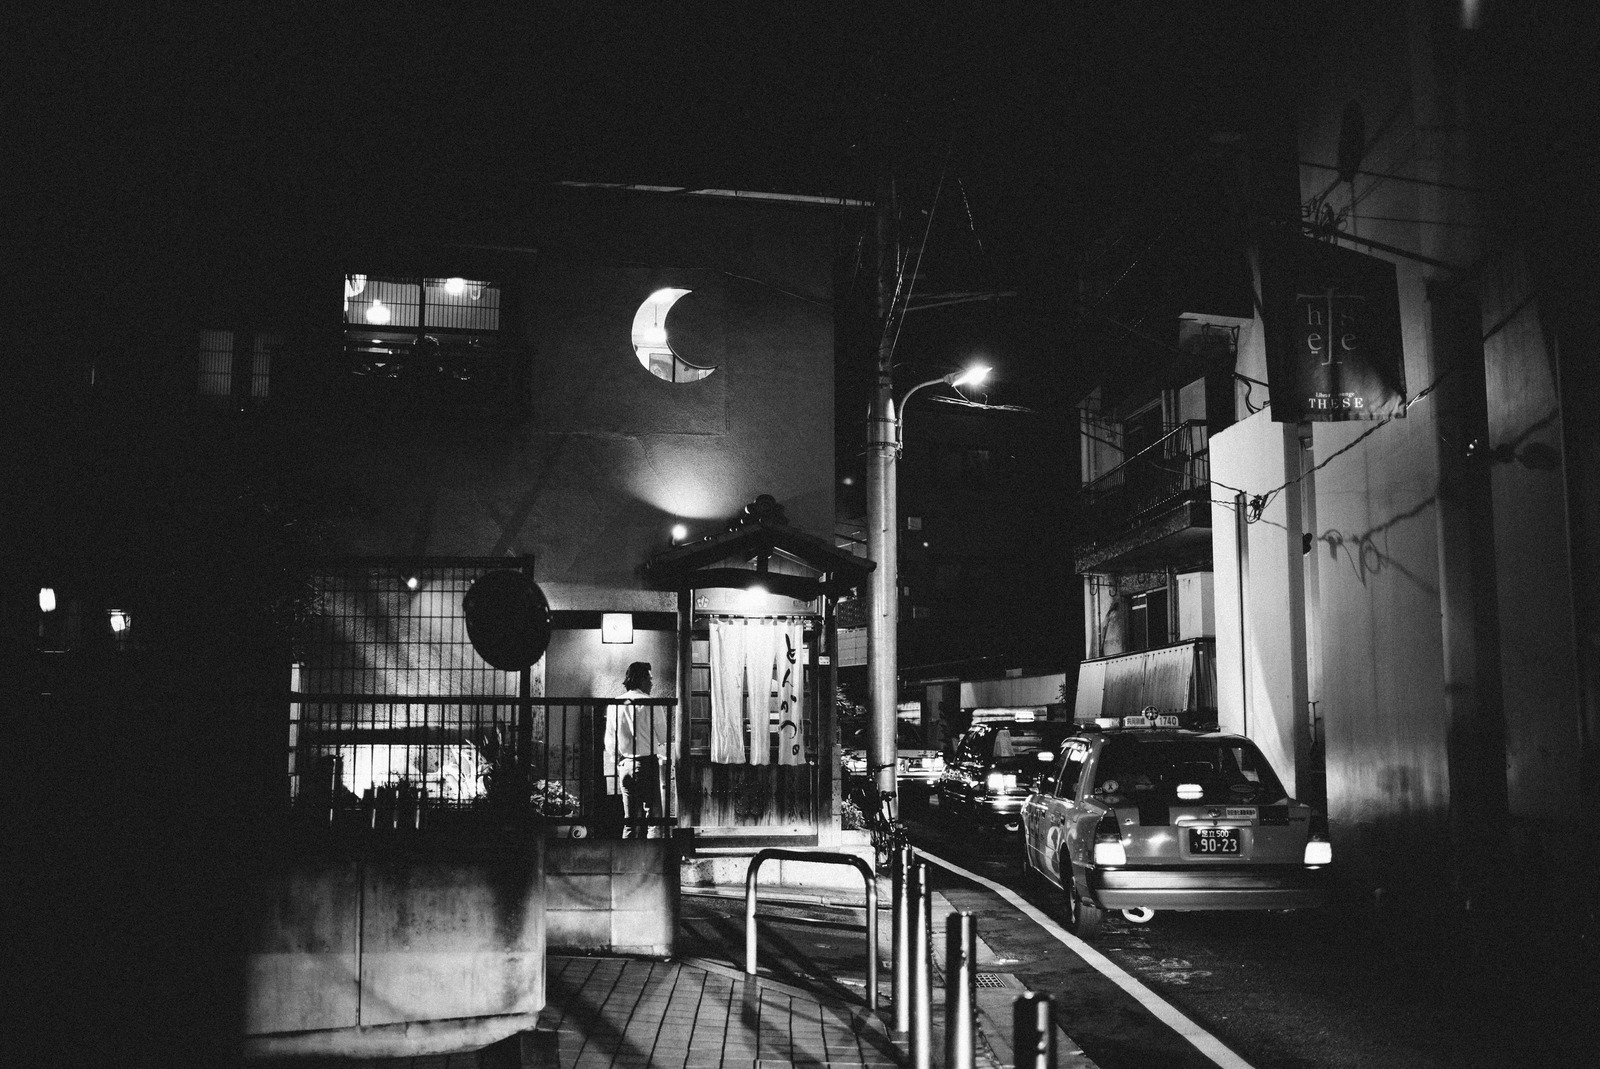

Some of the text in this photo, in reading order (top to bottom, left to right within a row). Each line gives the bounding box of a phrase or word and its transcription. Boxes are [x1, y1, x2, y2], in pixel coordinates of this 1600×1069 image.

[1308, 397, 1364, 409] THESE
[1159, 716, 1177, 725] 1740
[1216, 830, 1228, 838] 500
[1200, 838, 1237, 852] 90-23
